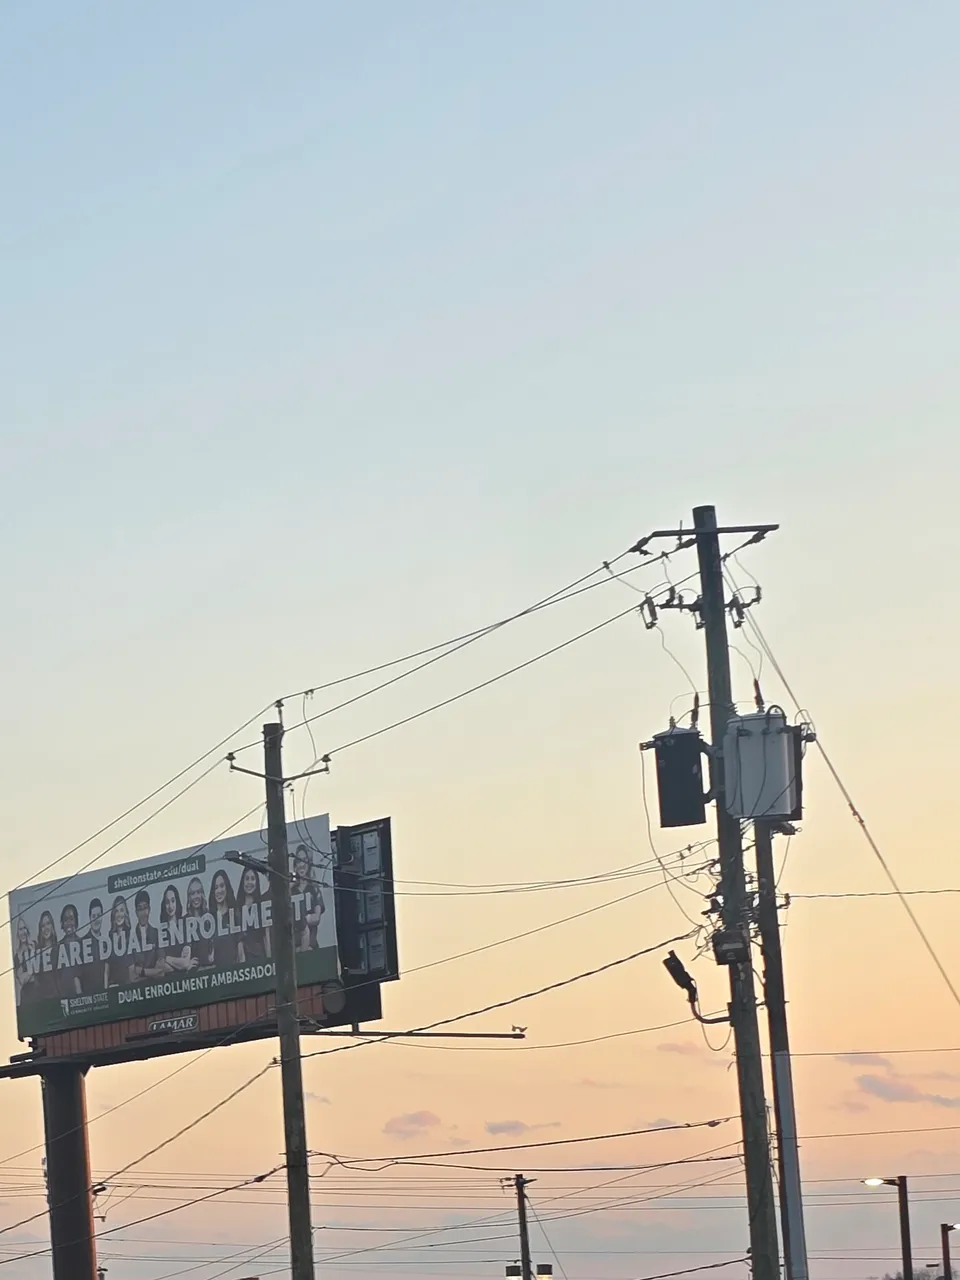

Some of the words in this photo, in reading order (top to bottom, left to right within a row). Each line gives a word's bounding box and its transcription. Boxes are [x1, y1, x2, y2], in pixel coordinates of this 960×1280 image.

[113, 861, 200, 889] sheltonstate.edu/dual
[24, 947, 52, 974] WE
[56, 938, 93, 970] ARE
[99, 926, 153, 961] DUAL
[158, 892, 312, 948] ENROLLMET!
[118, 986, 143, 1004] DUAL
[145, 976, 209, 999] ENROLLMENT
